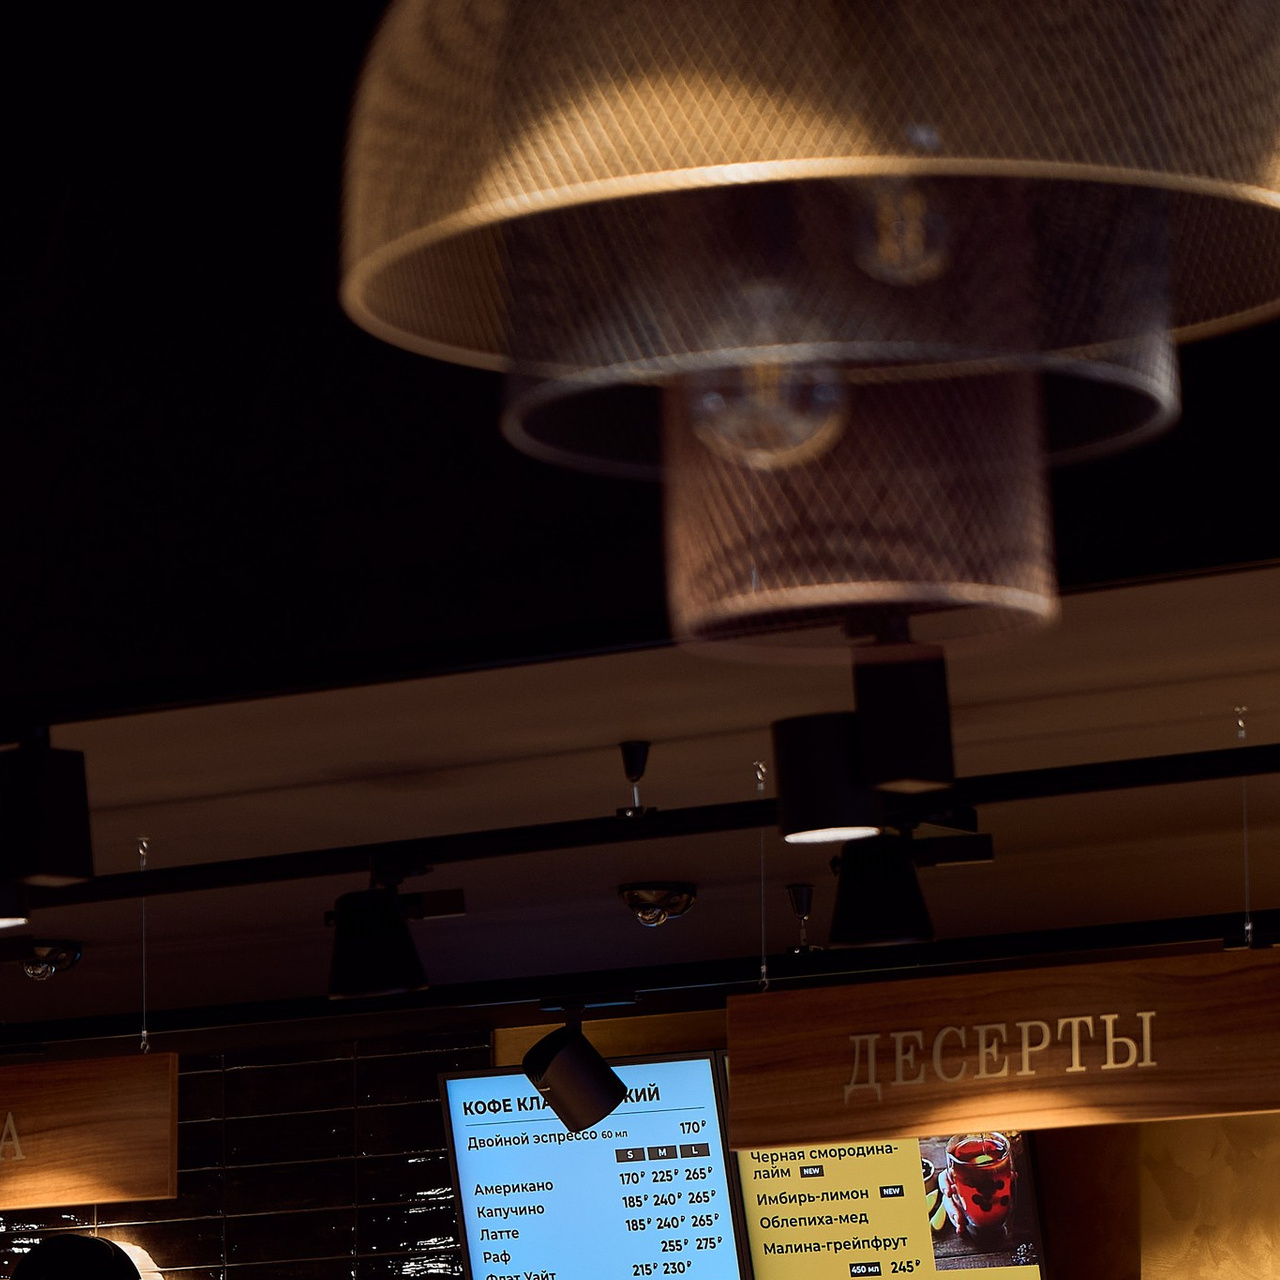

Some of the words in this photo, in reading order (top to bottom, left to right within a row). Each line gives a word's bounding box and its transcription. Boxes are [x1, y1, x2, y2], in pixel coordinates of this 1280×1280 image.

[844, 1011, 1157, 1106] ДЕСЕРТЫ
[463, 1098, 512, 1115] КОФЕ
[468, 1133, 529, 1151] Двойной
[533, 1130, 598, 1145] эспрессо
[602, 1131, 612, 1139] 60
[627, 1150, 634, 1159] S
[658, 1147, 667, 1157] M
[691, 1146, 699, 1155] L
[751, 1151, 805, 1165] Черная
[810, 1145, 898, 1160] смородина-
[754, 1166, 790, 1179] лайм
[803, 1167, 820, 1175] NEW
[475, 1182, 553, 1196] Американо
[757, 1190, 868, 1206] Имбирь-лимон
[882, 1187, 900, 1195] NEW
[477, 1205, 544, 1219] Капучино
[760, 1213, 868, 1229] Облепиха-мед
[480, 1229, 519, 1240] Латте
[764, 1236, 907, 1255] Малина-грейпфрут
[483, 1250, 510, 1265] Раф
[851, 1265, 867, 1274] 450
